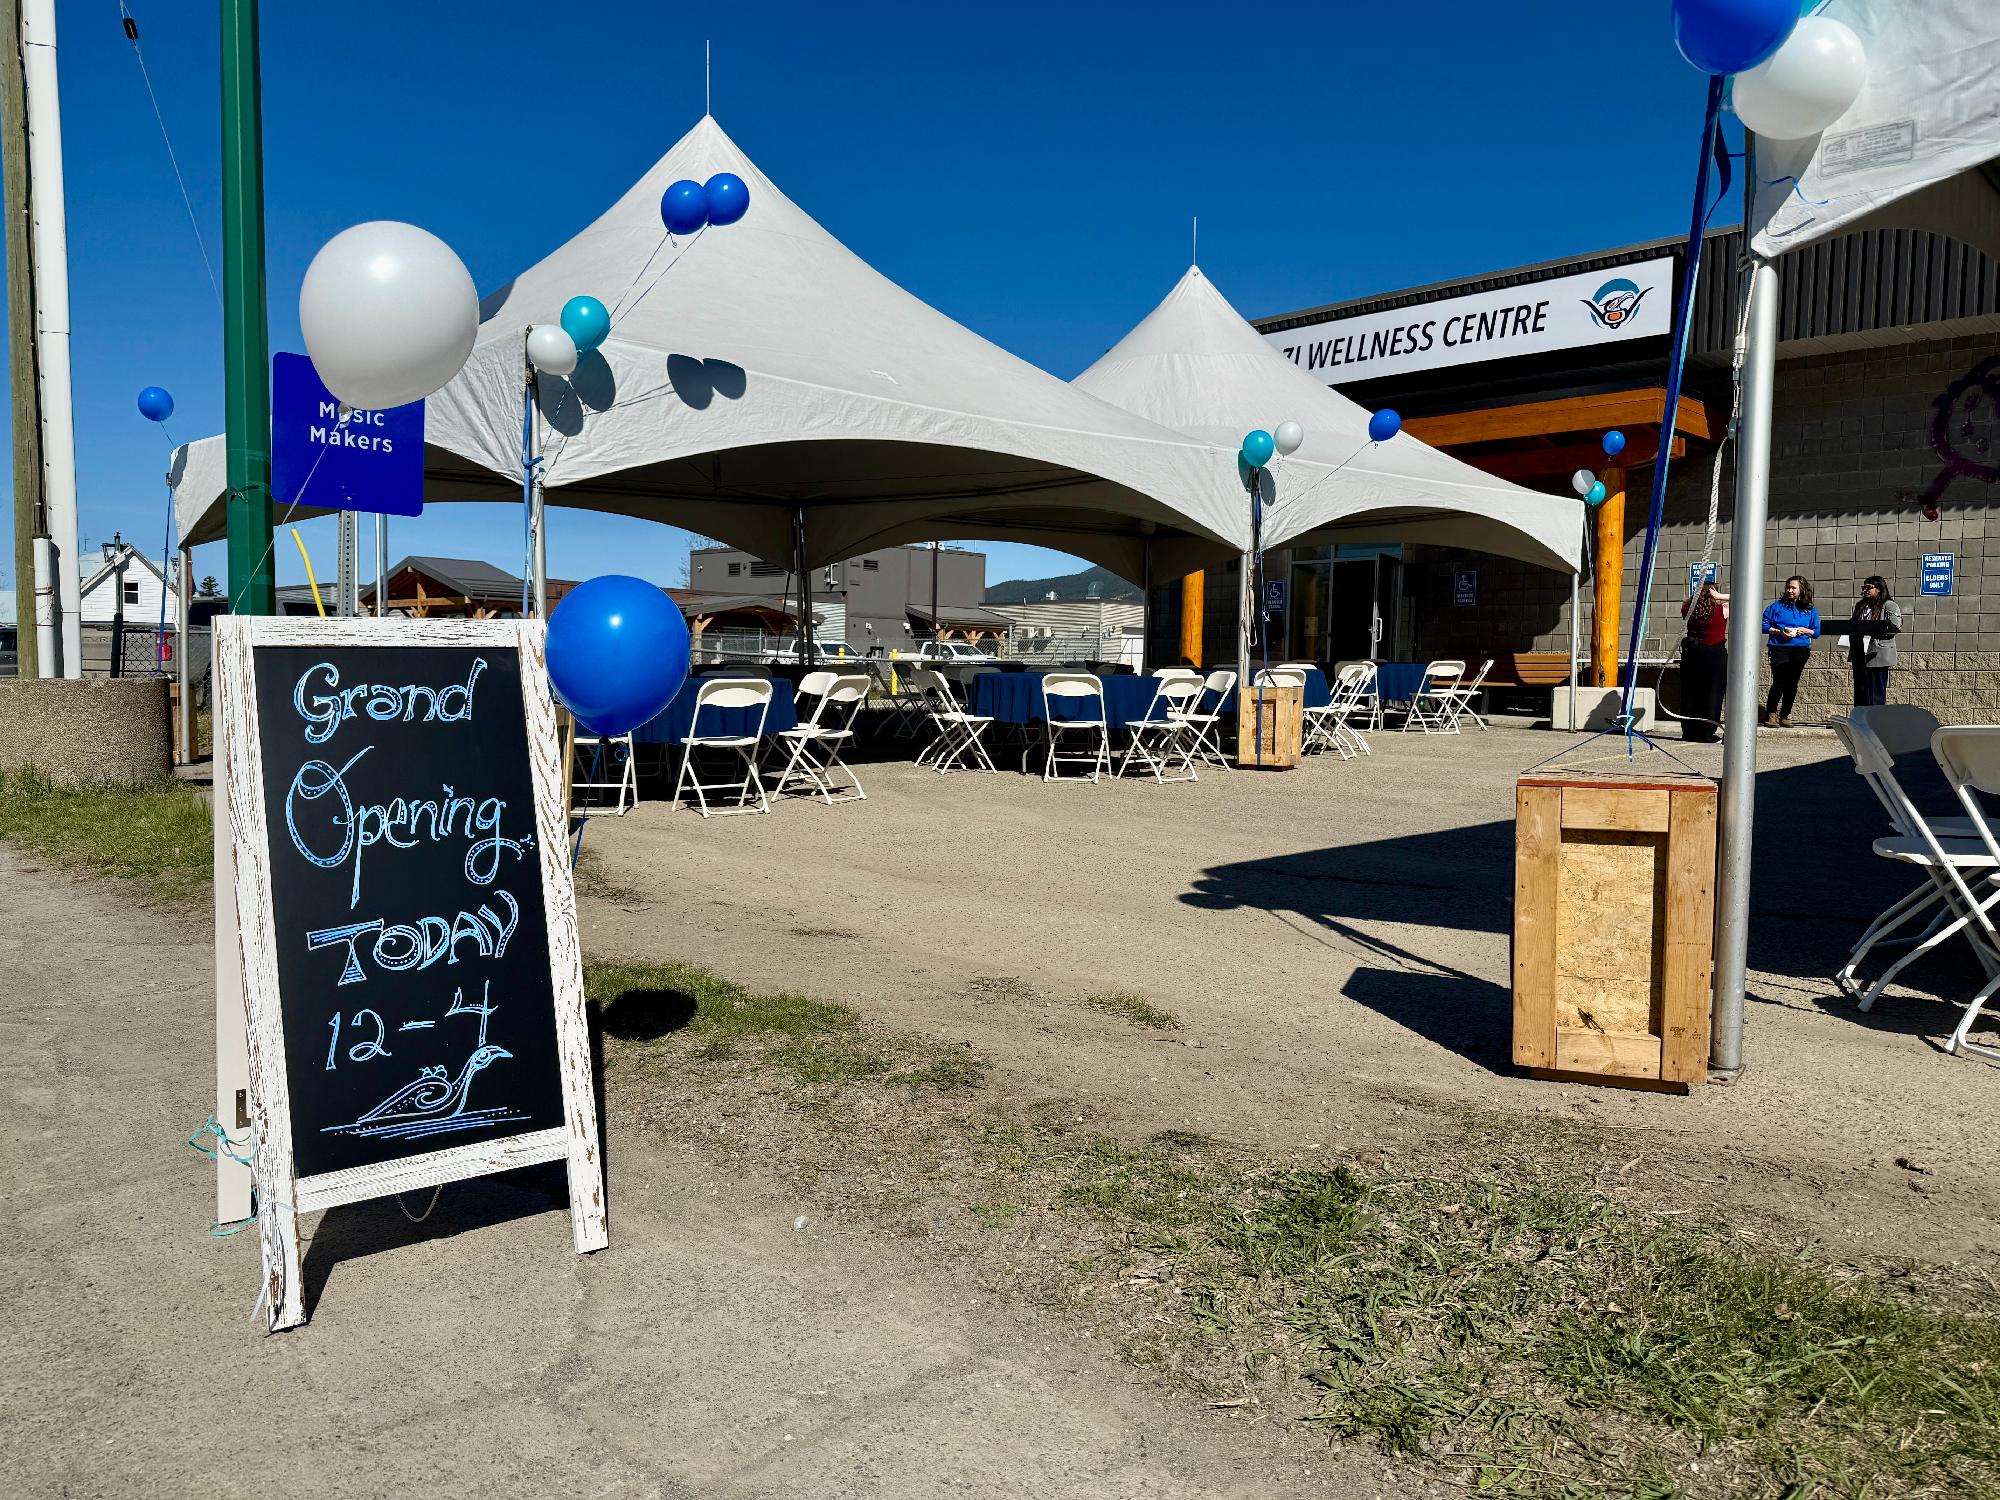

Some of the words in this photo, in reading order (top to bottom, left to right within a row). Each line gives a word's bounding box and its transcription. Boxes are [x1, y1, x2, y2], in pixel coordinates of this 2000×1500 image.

[1308, 320, 1437, 371] WELLNESS
[1442, 300, 1550, 347] CENTRE
[310, 425, 393, 453] Makers
[293, 657, 487, 744] Grand
[285, 745, 523, 910] Opening
[306, 889, 519, 986] TODAY
